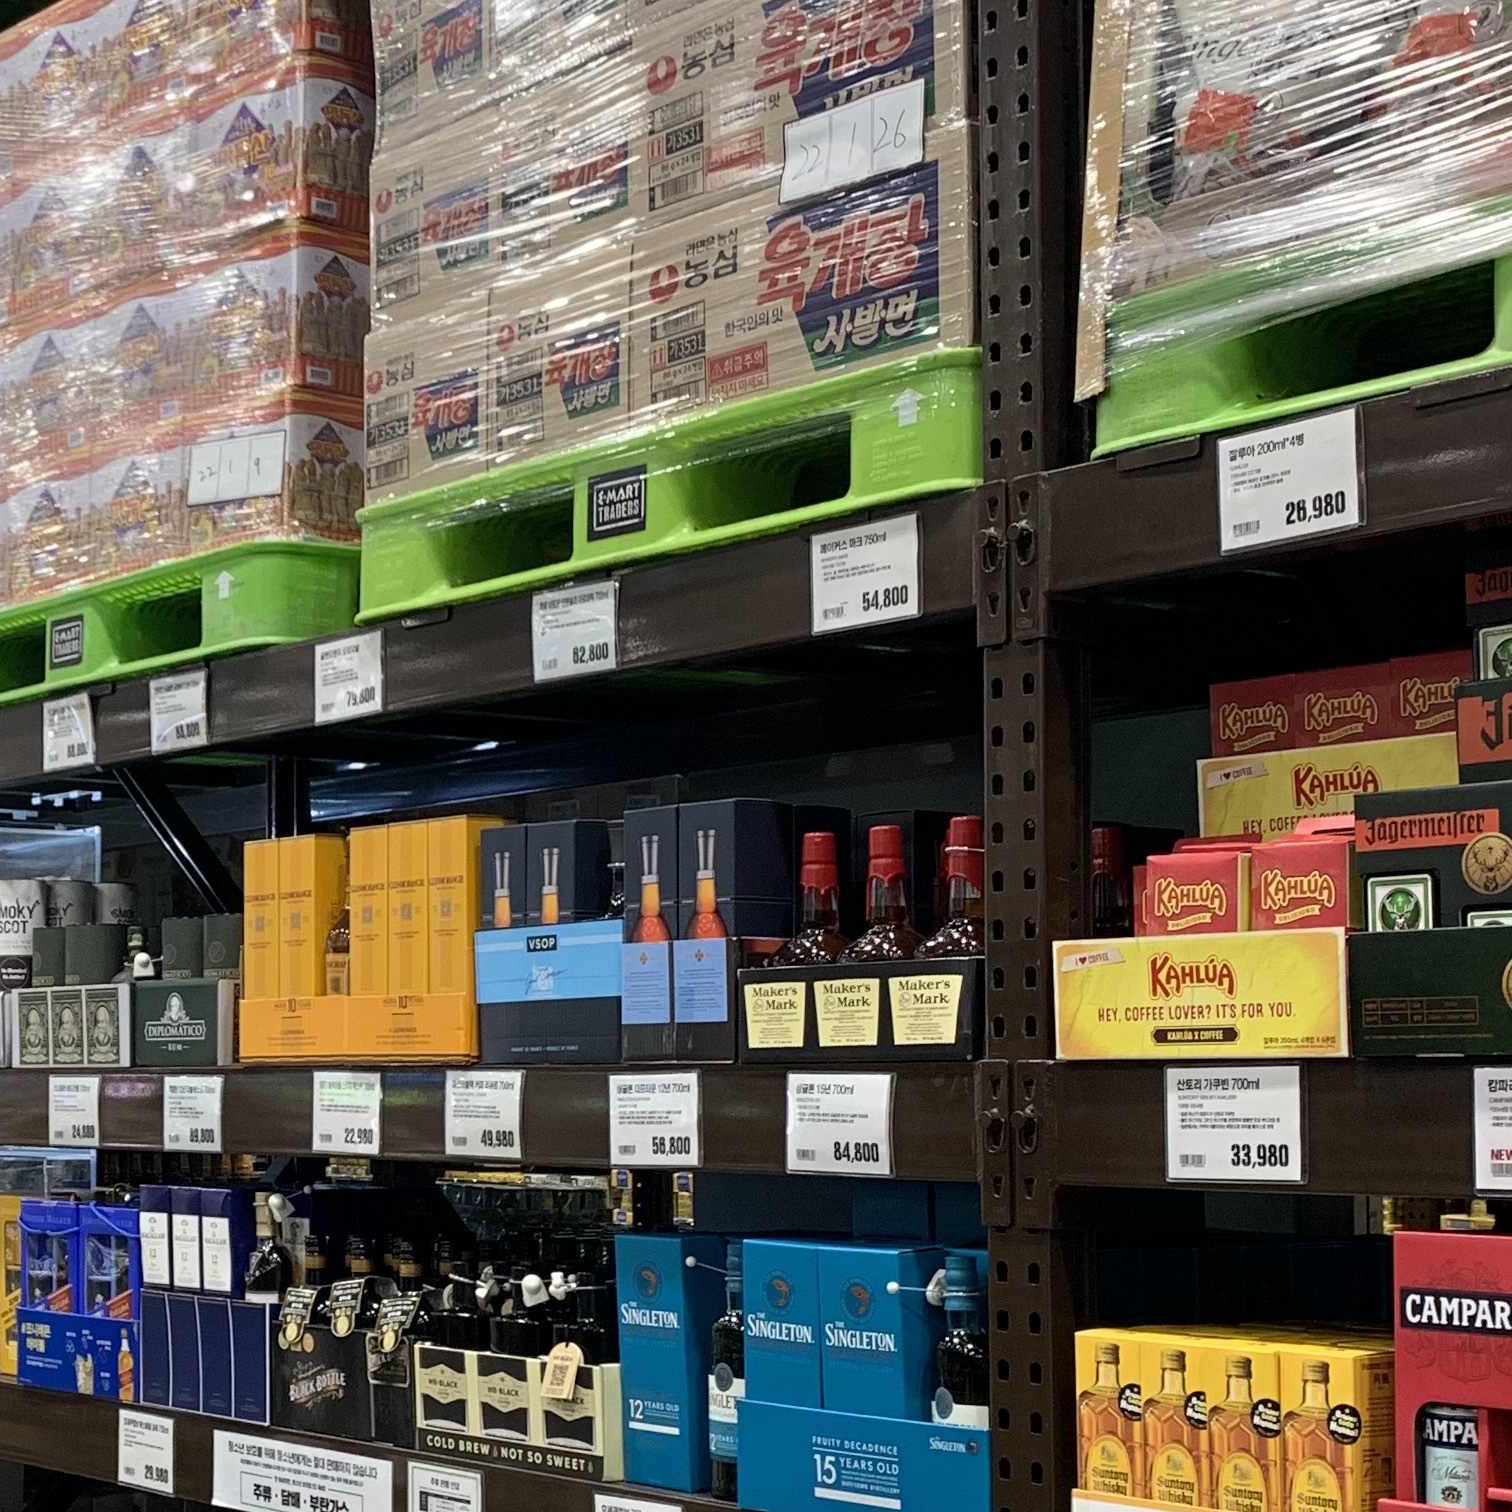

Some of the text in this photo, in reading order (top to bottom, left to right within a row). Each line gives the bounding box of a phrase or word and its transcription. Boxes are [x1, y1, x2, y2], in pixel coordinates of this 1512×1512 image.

[681, 34, 736, 80] 농심
[792, 145, 821, 181] 22
[872, 109, 906, 154] 26
[757, 193, 929, 312] 육개장
[685, 245, 738, 289] 농심
[724, 305, 784, 338] 한국인의 맛
[598, 500, 640, 523] TRADERS
[1285, 490, 1346, 525] 26,980
[862, 584, 908, 612] 54,800
[1218, 700, 1288, 740] KAHLÚA
[1305, 692, 1378, 731] KAHLÚA
[1292, 762, 1381, 809] KAHLÚA
[1154, 877, 1226, 918] KAHLÚA
[1261, 869, 1335, 910] KAHLÚA
[529, 937, 555, 950] VSOP
[822, 983, 871, 995] Maker's
[898, 978, 951, 991] Maker's
[1149, 953, 1237, 1000] KAHLÚA
[835, 995, 871, 1008] Mark
[912, 992, 950, 1005] Mark
[1098, 1002, 1295, 1023] HEY, COFFEE LOVER? IT'S FOR YOU.
[832, 1084, 855, 1095] 700ml
[1177, 1077, 1260, 1091] 산토리 가쿠빈 700ml
[481, 1129, 514, 1149] 49,980
[833, 1141, 880, 1163] 84,800
[1231, 1144, 1289, 1169] 33,980
[1405, 1293, 1512, 1331] CAMPAR
[629, 1399, 680, 1420] 12 YEARS OLD
[426, 1435, 586, 1472] COLD BREW NOT SO SWEET
[813, 1436, 898, 1455] FRUITY DECADENCE
[814, 1453, 837, 1484] 15
[839, 1456, 899, 1475] YEARS OLD
[253, 1483, 272, 1503] 주류
[281, 1488, 301, 1509] 담배
[1224, 1485, 1263, 1501] Suntory
[1297, 1492, 1338, 1510] Suntory
